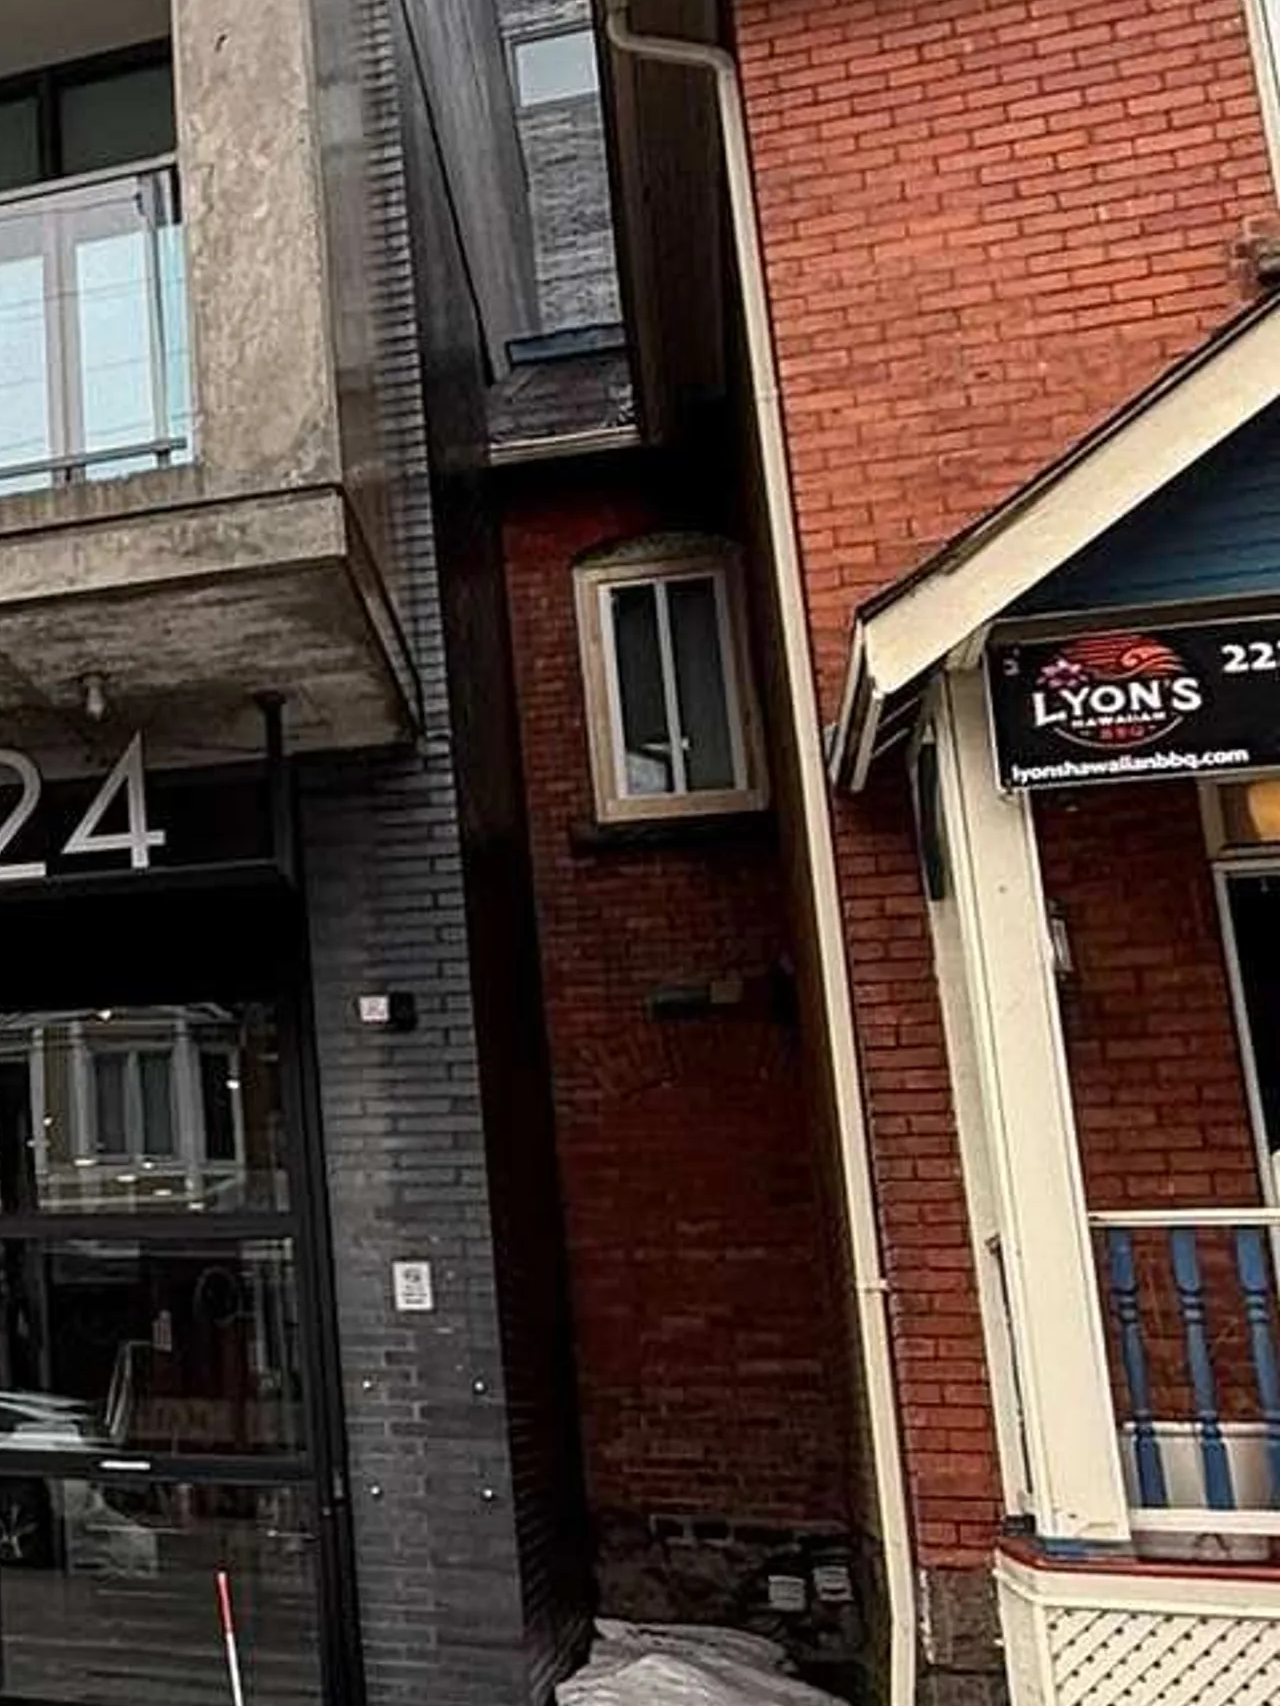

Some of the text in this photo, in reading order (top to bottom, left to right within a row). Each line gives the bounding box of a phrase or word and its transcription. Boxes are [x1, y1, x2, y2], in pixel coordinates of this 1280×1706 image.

[1222, 641, 1280, 672] 22
[1032, 677, 1203, 726] LYON'S
[1011, 748, 1250, 783] lyonshawaiianbbq.com
